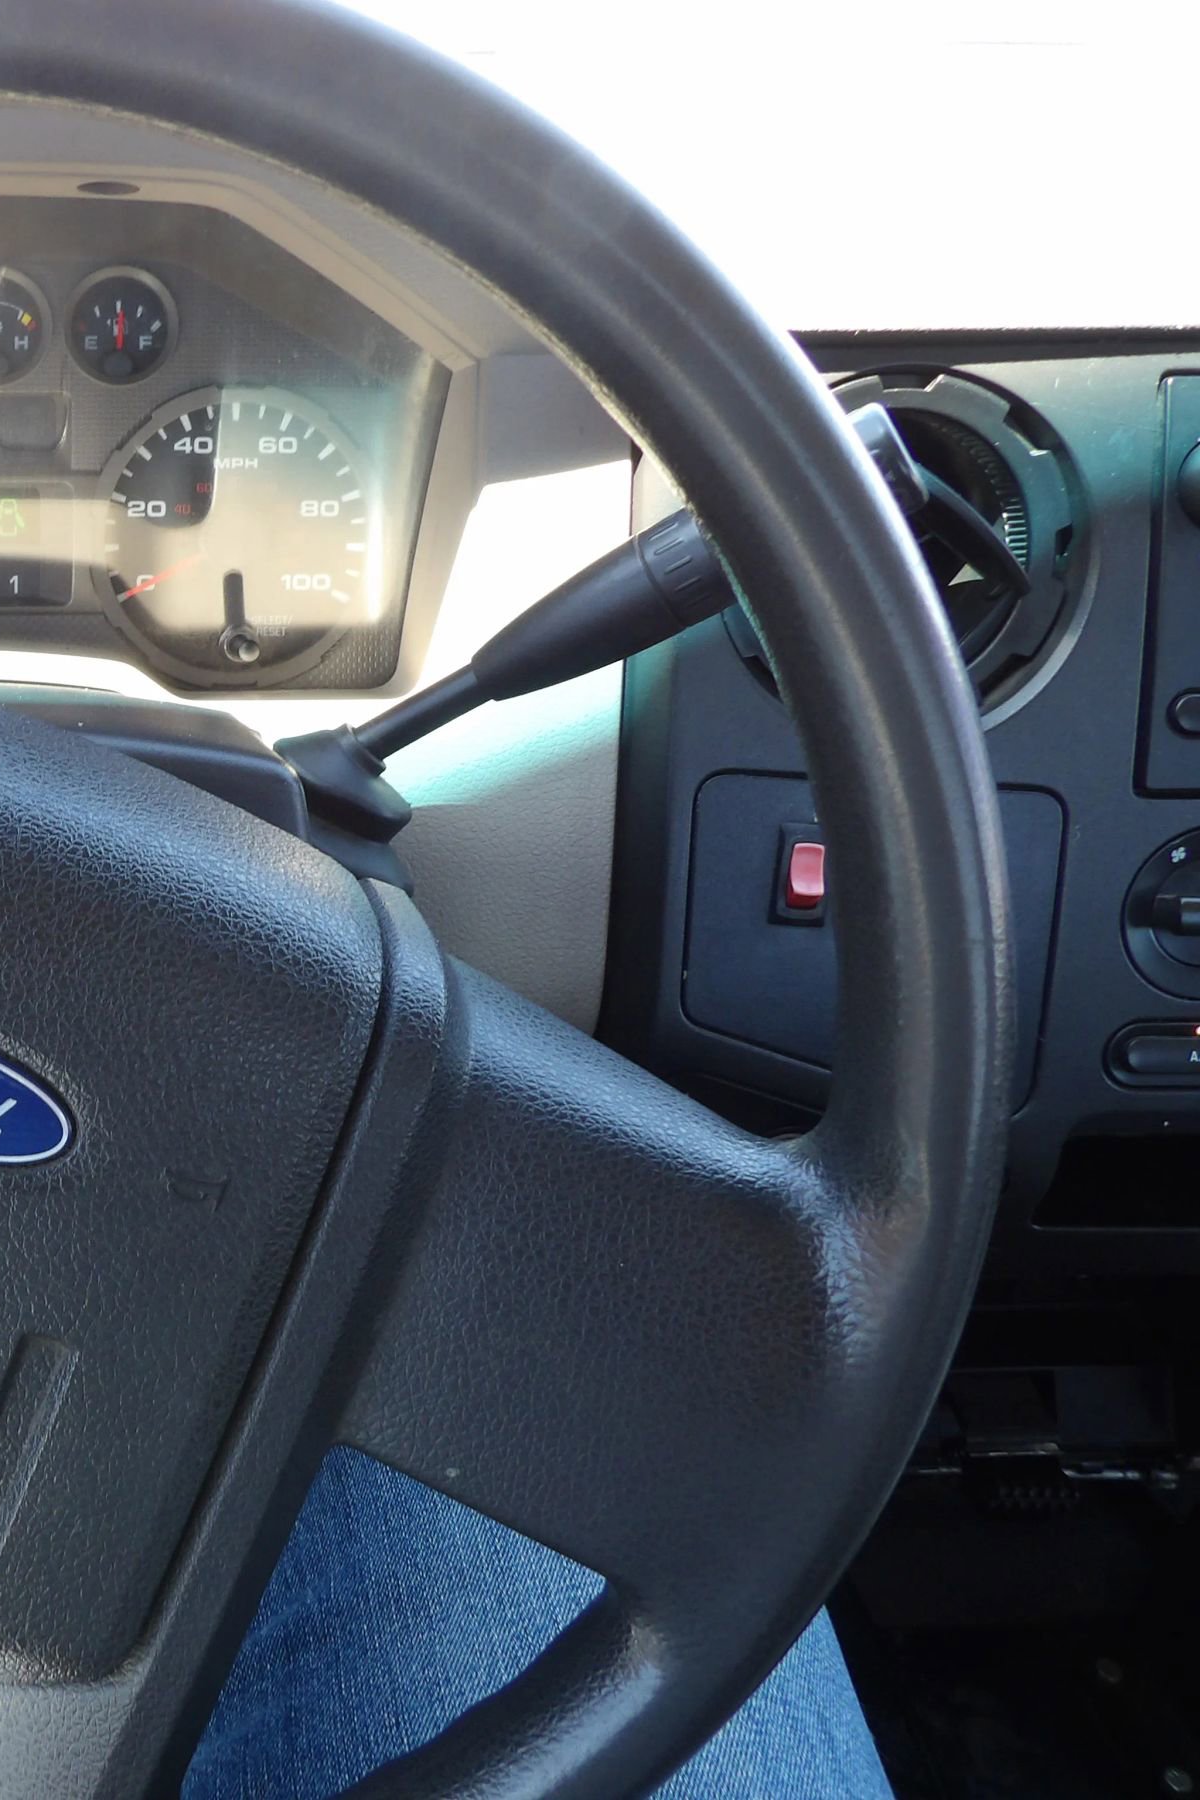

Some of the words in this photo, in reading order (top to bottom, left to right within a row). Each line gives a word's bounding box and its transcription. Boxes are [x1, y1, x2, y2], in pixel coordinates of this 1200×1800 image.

[14, 337, 29, 350] H
[84, 337, 98, 350] E
[138, 337, 153, 350] F
[173, 436, 213, 455] 40
[258, 436, 298, 455] 60
[213, 458, 258, 470] MPH
[127, 500, 167, 518] 20
[300, 500, 340, 518] 80
[8, 576, 20, 594] 1
[281, 574, 332, 592] 100
[256, 626, 287, 637] RESET
